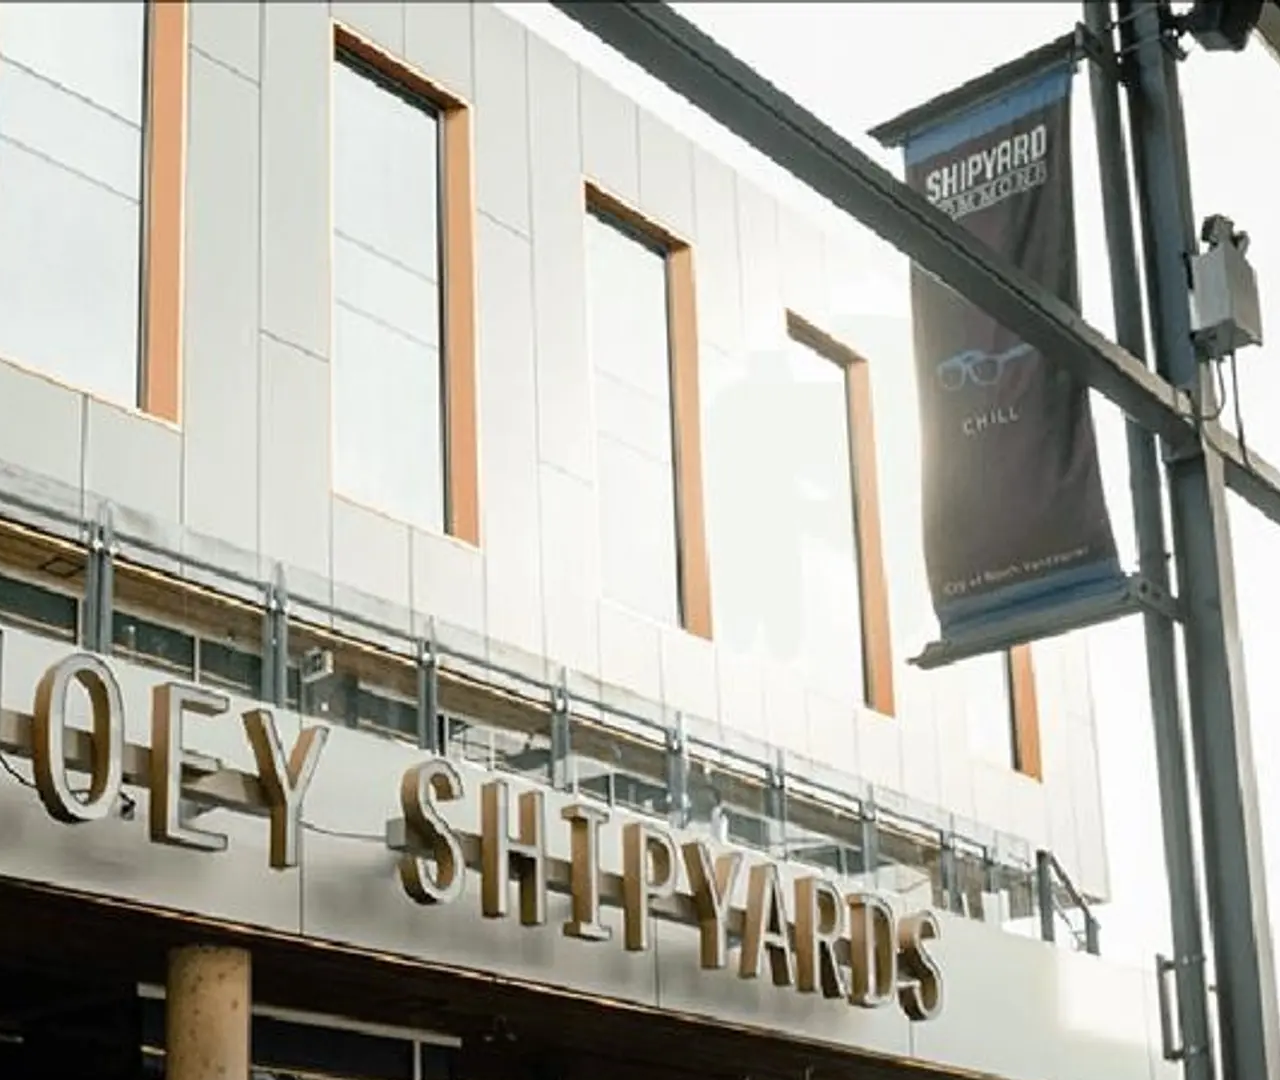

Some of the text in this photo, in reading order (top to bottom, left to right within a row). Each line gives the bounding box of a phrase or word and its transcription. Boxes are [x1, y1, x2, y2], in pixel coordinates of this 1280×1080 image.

[926, 124, 1047, 204] SHIPYARD
[963, 407, 1019, 437] CHILL
[398, 757, 945, 1022] SHIPYARDS
